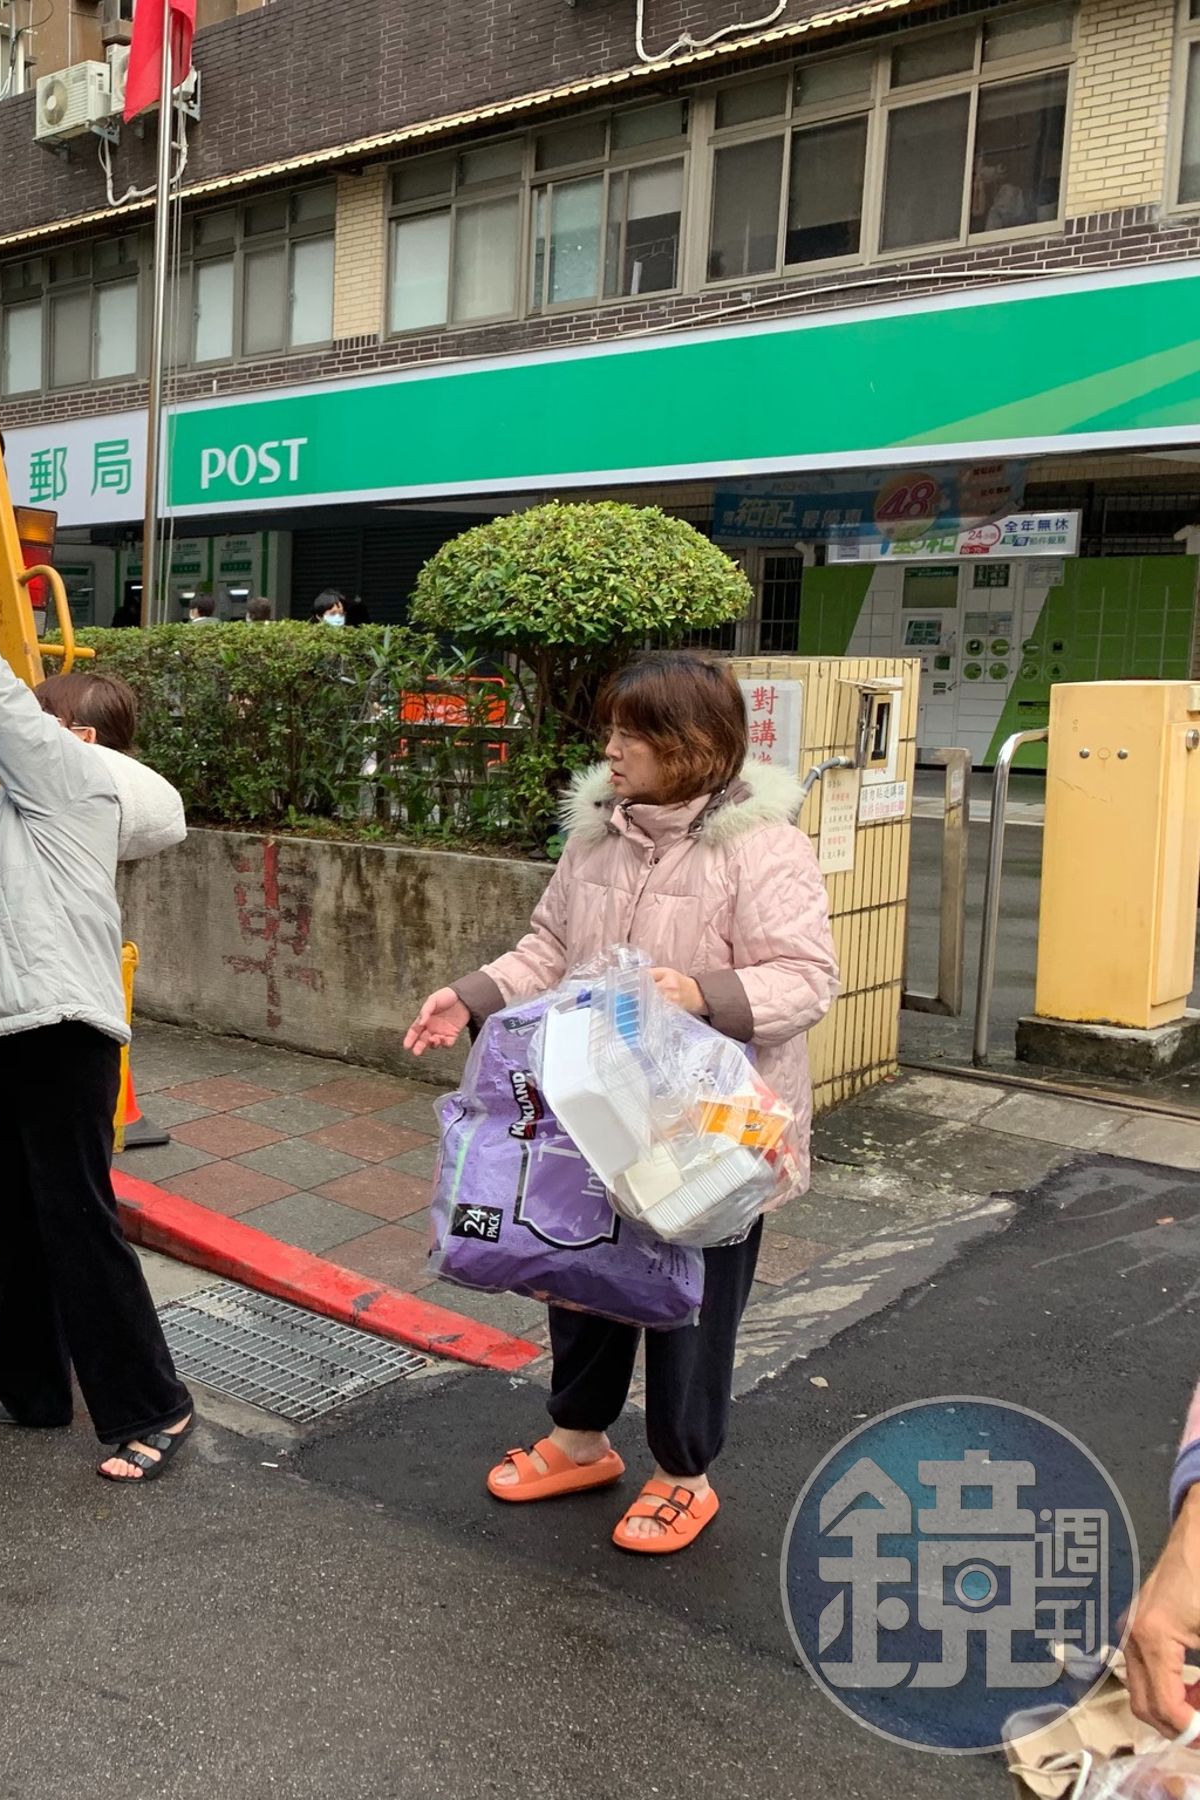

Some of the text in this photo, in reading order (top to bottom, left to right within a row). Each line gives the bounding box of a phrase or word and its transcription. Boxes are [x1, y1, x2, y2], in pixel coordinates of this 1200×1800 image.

[28, 438, 133, 504] 郵局
[200, 437, 308, 490] POST
[1005, 518, 1070, 534] 全年無休
[463, 1208, 487, 1236] 24
[486, 1213, 500, 1239] PACK
